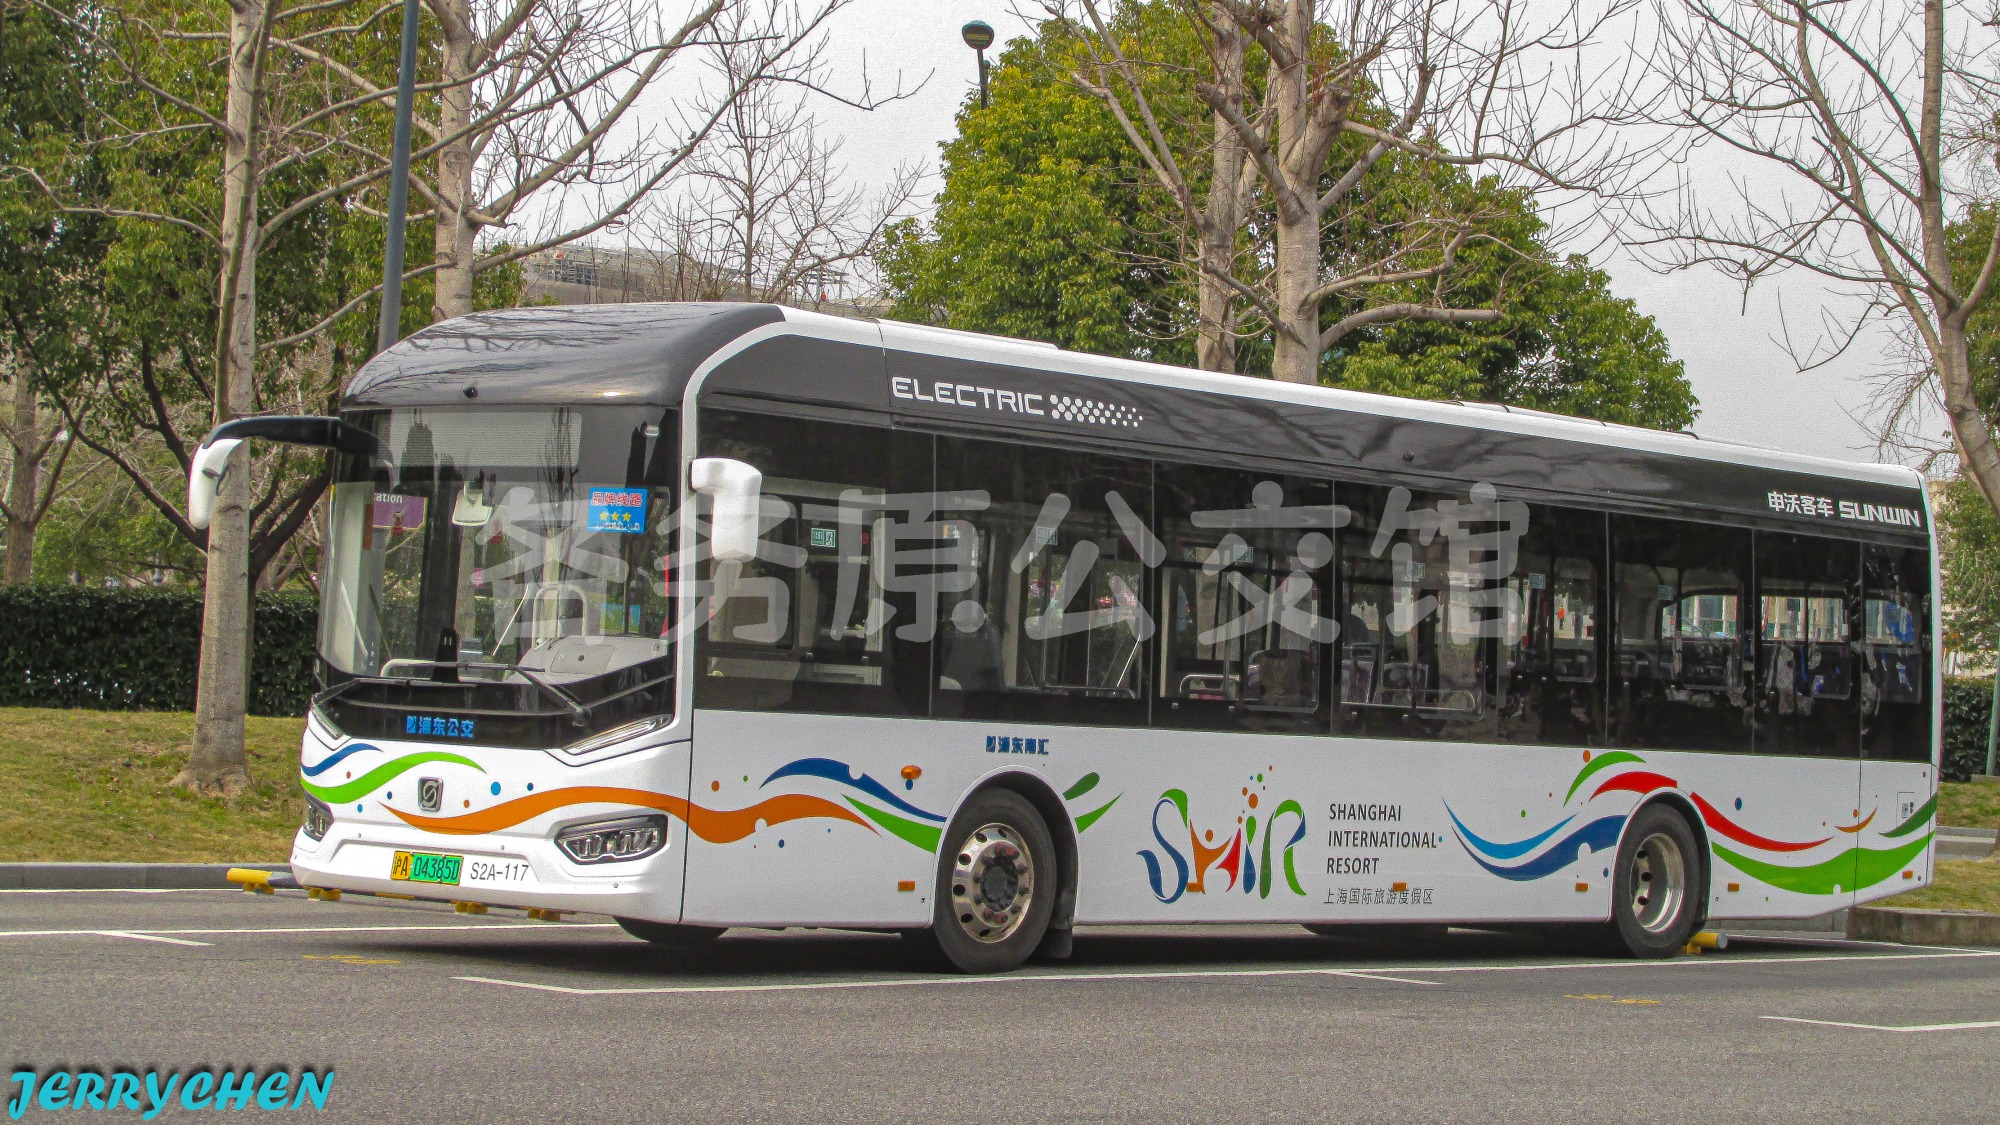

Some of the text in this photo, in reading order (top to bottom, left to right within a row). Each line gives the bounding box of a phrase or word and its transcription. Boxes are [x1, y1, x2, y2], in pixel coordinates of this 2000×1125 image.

[891, 375, 1045, 416] ELECTRIC
[373, 493, 403, 504] ation
[591, 492, 643, 508] 品牌线路
[1767, 491, 1921, 527] 申沃客车 SUNWIN
[418, 716, 474, 739] 浦东公交
[998, 736, 1049, 755] 浦东南汇
[1329, 803, 1402, 822] SHANGHAI
[1328, 831, 1437, 849] INTERNATIONAL
[470, 861, 529, 881] S2A-117
[1326, 857, 1380, 875] RESORT
[1323, 888, 1434, 905] 上海国际旅游度假区
